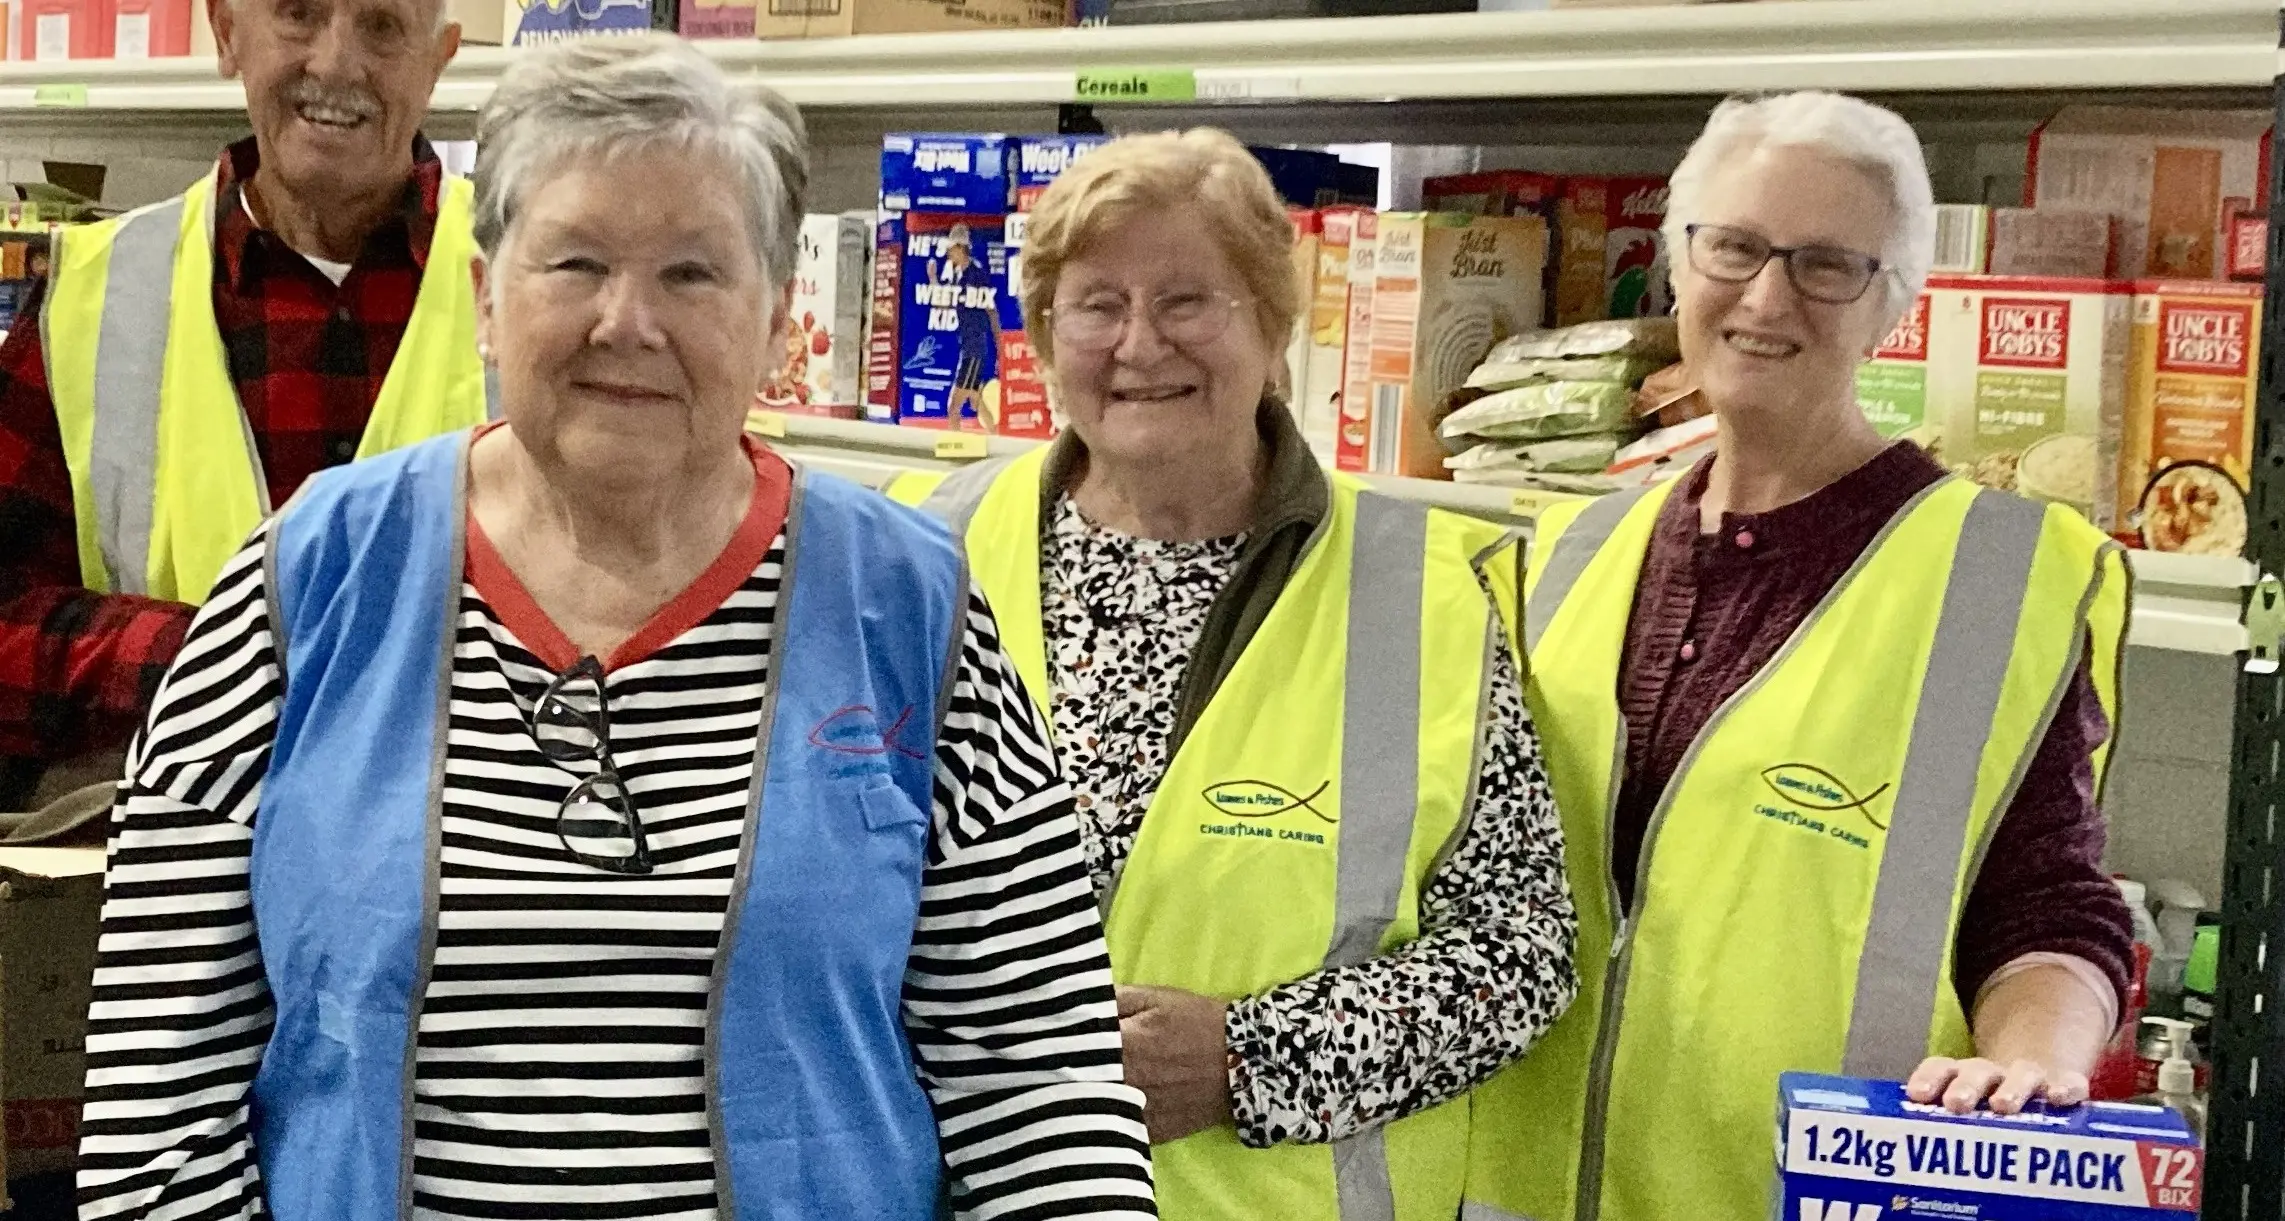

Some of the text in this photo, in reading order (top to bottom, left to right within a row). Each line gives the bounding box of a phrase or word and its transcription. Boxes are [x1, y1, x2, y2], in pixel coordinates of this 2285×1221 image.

[1077, 76, 1148, 95] Cereals
[1458, 228, 1499, 254] Just
[1379, 249, 1416, 264] Bran
[1450, 252, 1505, 279] Bran
[915, 284, 997, 310] WEET-BIX
[928, 308, 959, 331] KID
[1987, 308, 2061, 333] UNCLE
[2167, 314, 2242, 339] UNCLE
[1986, 332, 2062, 357] TOBYS
[2165, 338, 2243, 363] TOBYS
[1279, 829, 1324, 844] CARING
[1804, 1124, 2126, 1192] 1.2kg VALUE PACK
[2151, 1148, 2197, 1188] 72
[2158, 1187, 2193, 1206] BIX
